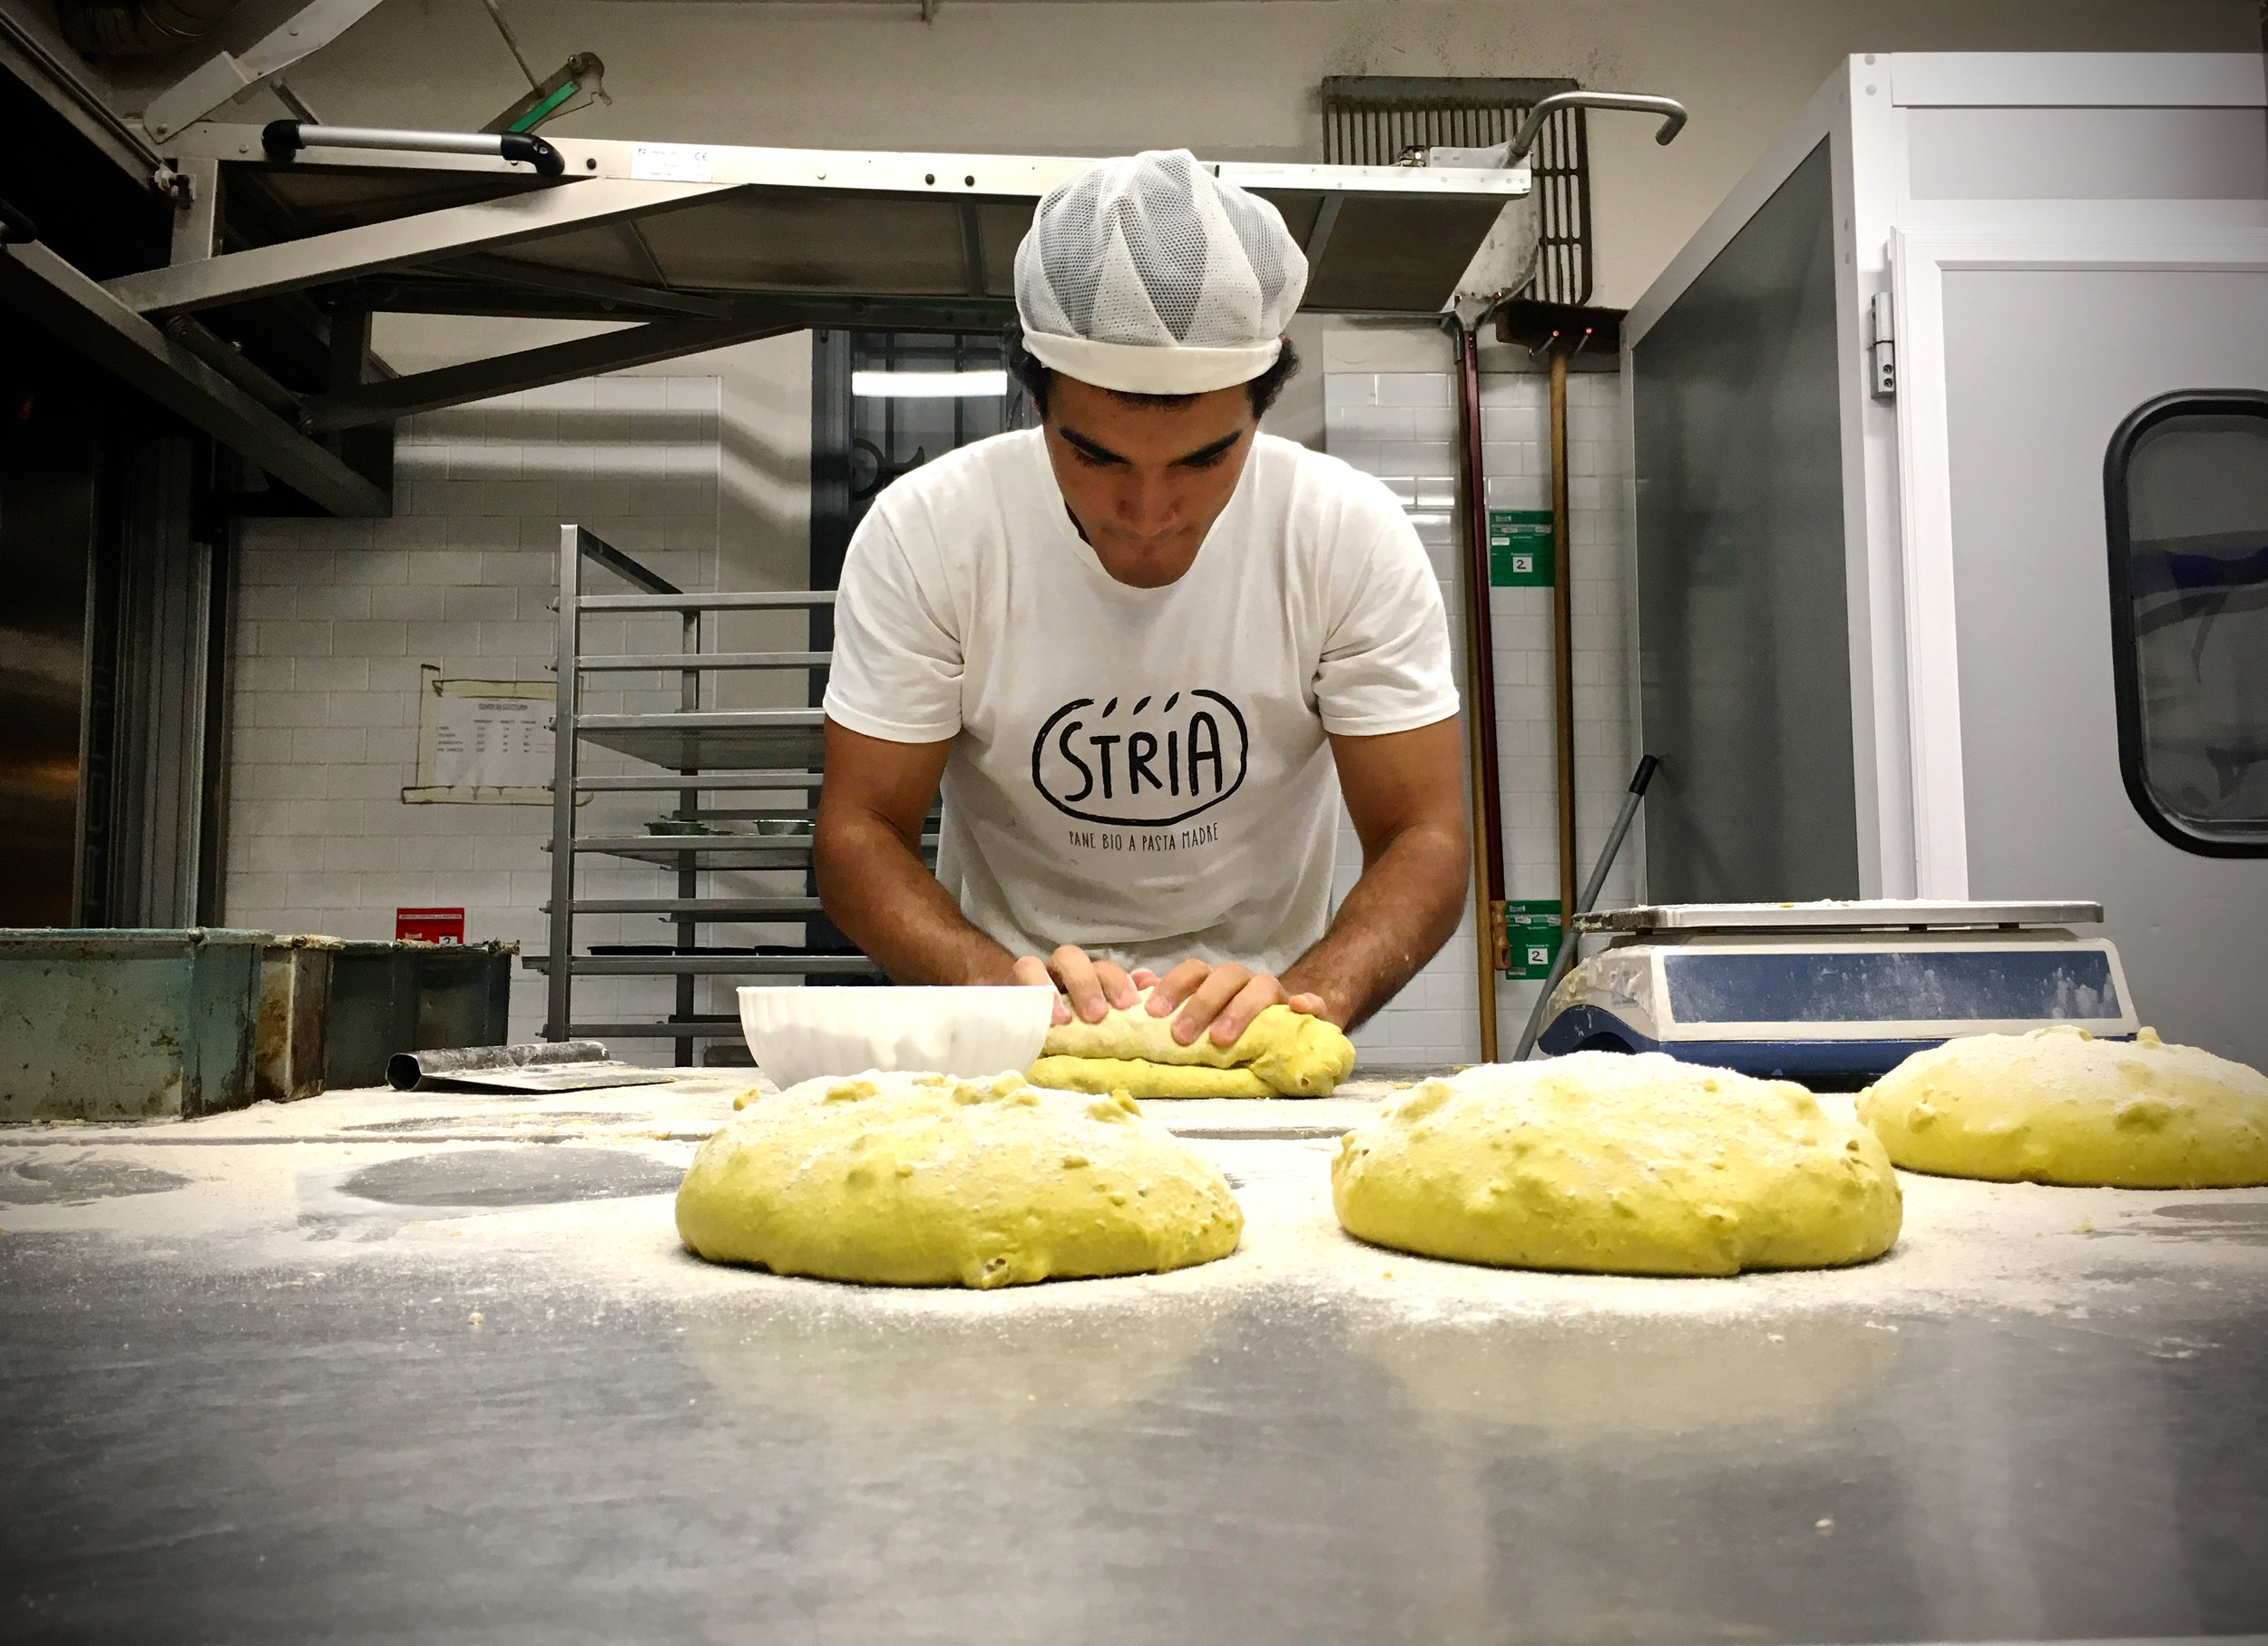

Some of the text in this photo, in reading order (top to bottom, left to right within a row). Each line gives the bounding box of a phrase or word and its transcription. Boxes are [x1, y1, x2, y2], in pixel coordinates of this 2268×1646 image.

[1516, 559, 1526, 570] 2
[1059, 711, 1223, 802] STRIA
[1069, 822, 1218, 852] PANE BIO A PASTA MADRE
[1531, 950, 1544, 962] 2
